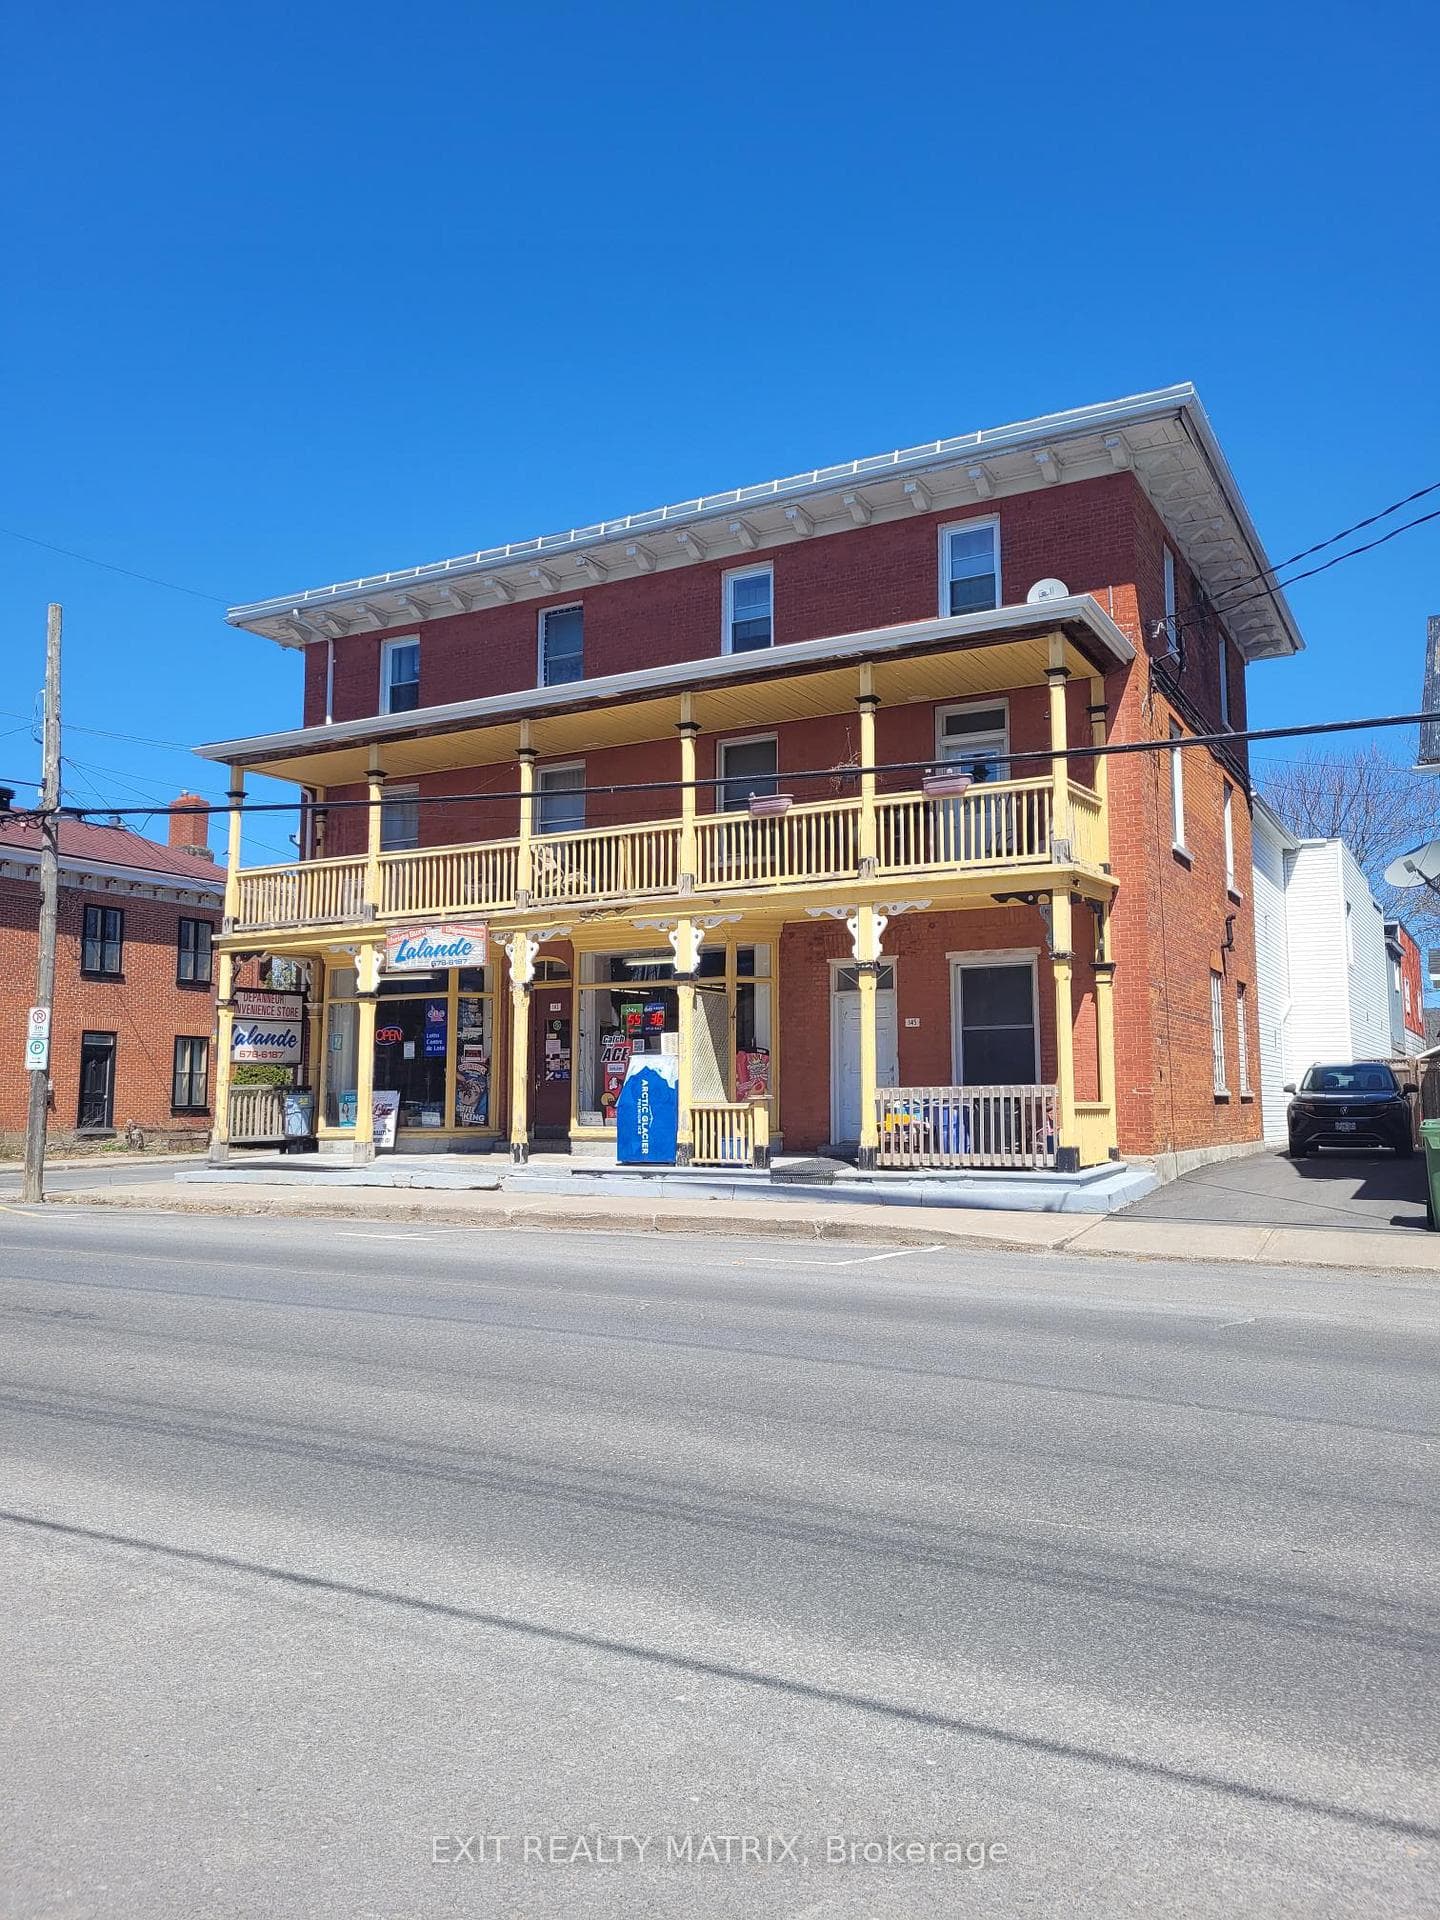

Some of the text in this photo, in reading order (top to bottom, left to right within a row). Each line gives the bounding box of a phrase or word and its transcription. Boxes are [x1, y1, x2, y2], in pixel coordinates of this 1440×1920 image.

[395, 937, 472, 963] Lalande
[233, 1003, 299, 1018] NVENIENCE STORE
[376, 1030, 402, 1041] OPEN
[602, 1034, 625, 1044] Catch
[600, 1046, 631, 1062] ACE
[641, 1079, 649, 1154] ARCTIC GLACIER
